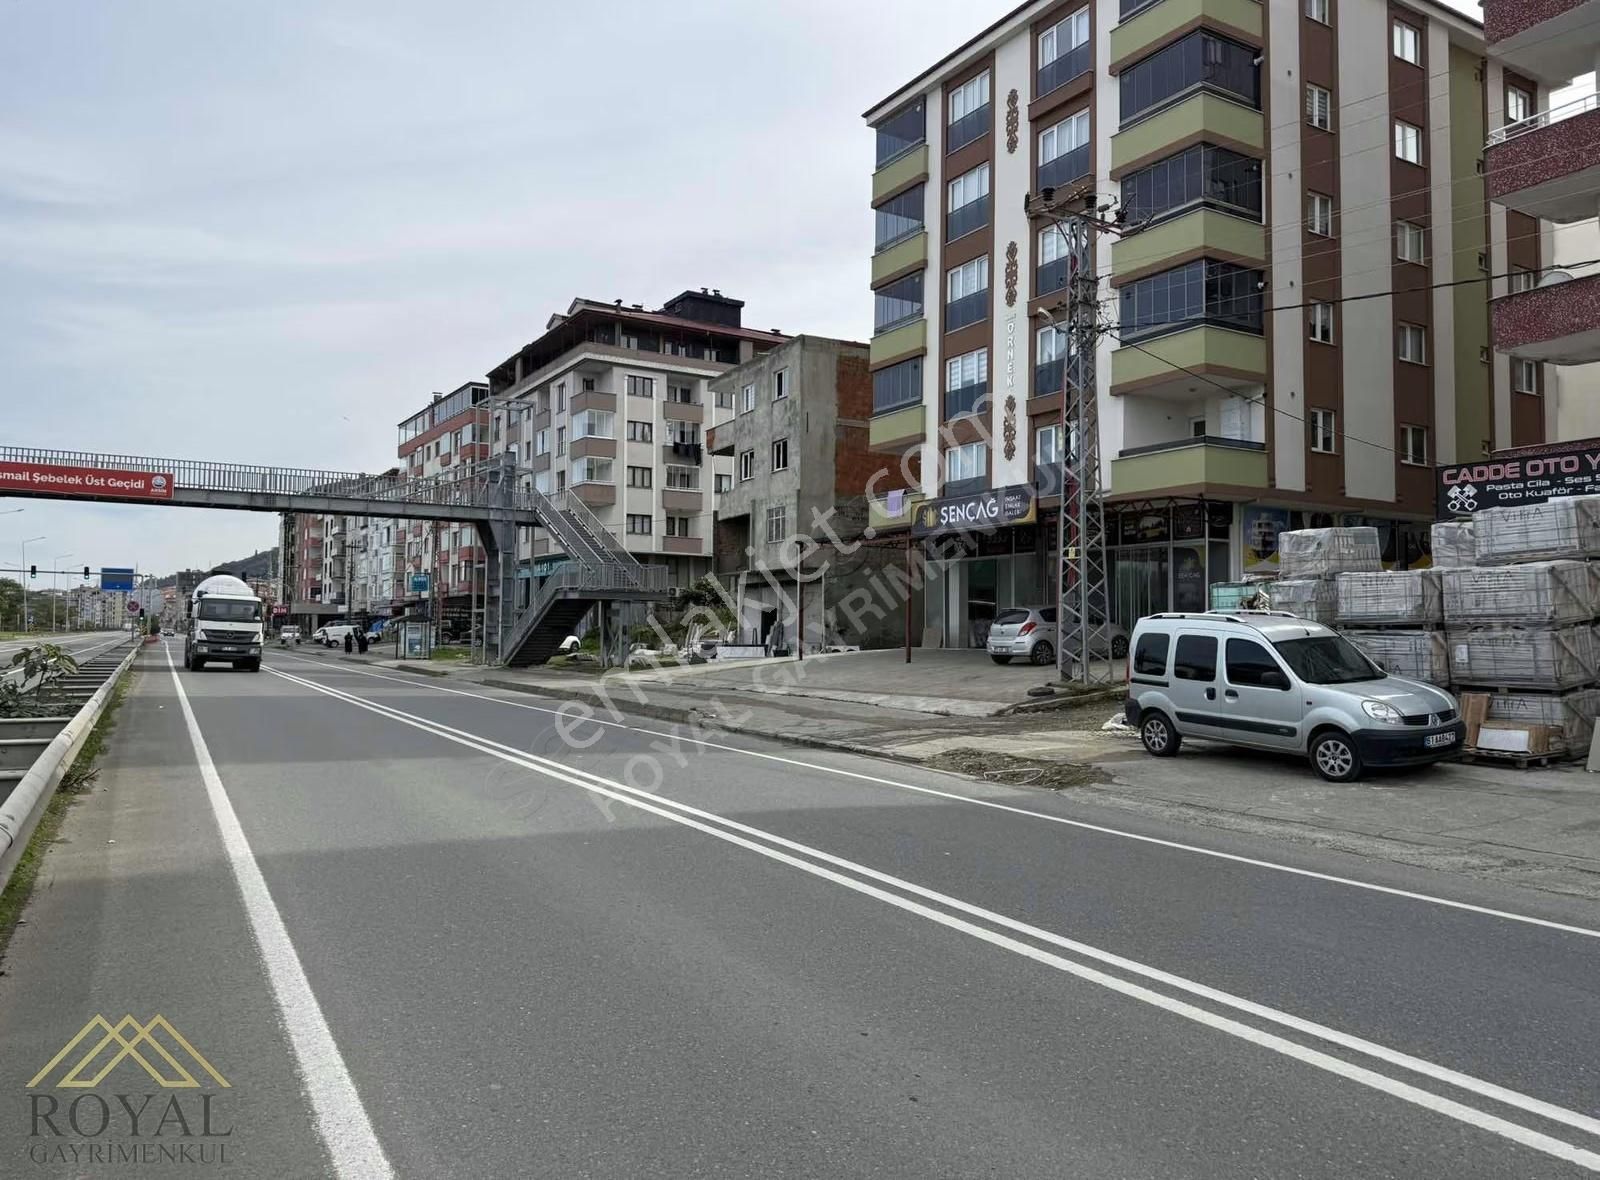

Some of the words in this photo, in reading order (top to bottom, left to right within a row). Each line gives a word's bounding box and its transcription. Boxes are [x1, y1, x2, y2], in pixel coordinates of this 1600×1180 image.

[1442, 462, 1521, 485] CADDE
[1526, 455, 1579, 477] OTO
[32, 472, 83, 485] Şebelek
[85, 474, 105, 487] Üst
[107, 478, 145, 490] Geçidi
[1486, 483, 1524, 492] Pasta
[1527, 479, 1551, 488] Cila
[1564, 475, 1592, 484] Ses
[1498, 492, 1523, 500] Oto
[1525, 487, 1574, 498] Kuaför
[940, 497, 999, 526] ŞENÇAĞ
